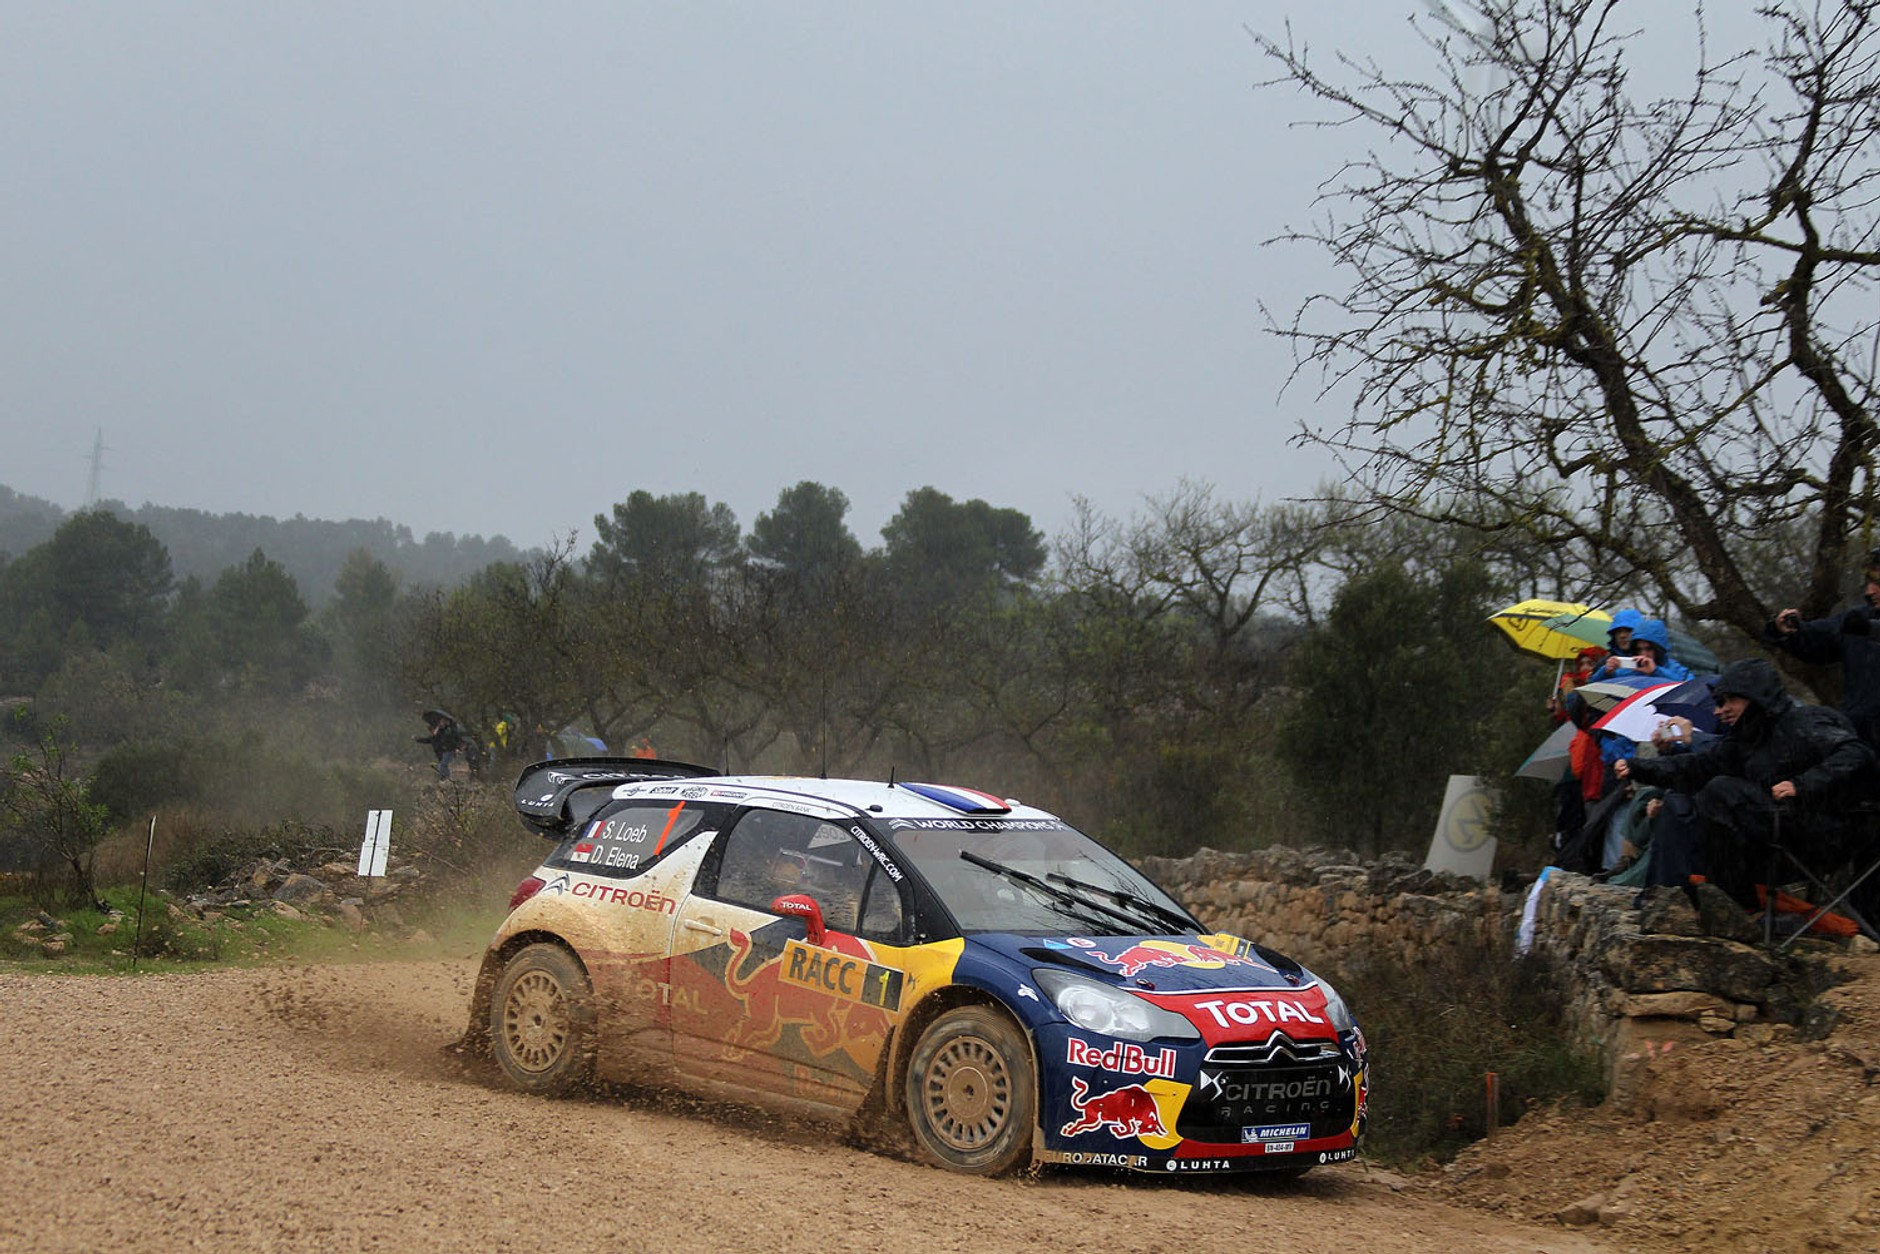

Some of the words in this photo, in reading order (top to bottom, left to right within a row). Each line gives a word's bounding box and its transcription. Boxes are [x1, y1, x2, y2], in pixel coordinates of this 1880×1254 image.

[602, 821, 613, 839] S.
[616, 822, 648, 843] Loeb
[653, 801, 686, 855] 1
[914, 819, 975, 830] WORLD
[590, 845, 602, 863] D.
[606, 847, 640, 869] Elena
[572, 882, 676, 914] CITROËN
[782, 901, 812, 911] TOTAL
[789, 947, 856, 995] RACC
[878, 970, 890, 1006] 1
[618, 974, 709, 1015] OTAL
[1194, 1000, 1324, 1028] TOTAL
[1220, 1101, 1331, 1117] RACING
[1260, 1126, 1306, 1138] MICHELIN
[1181, 1160, 1230, 1170] LUHTA
